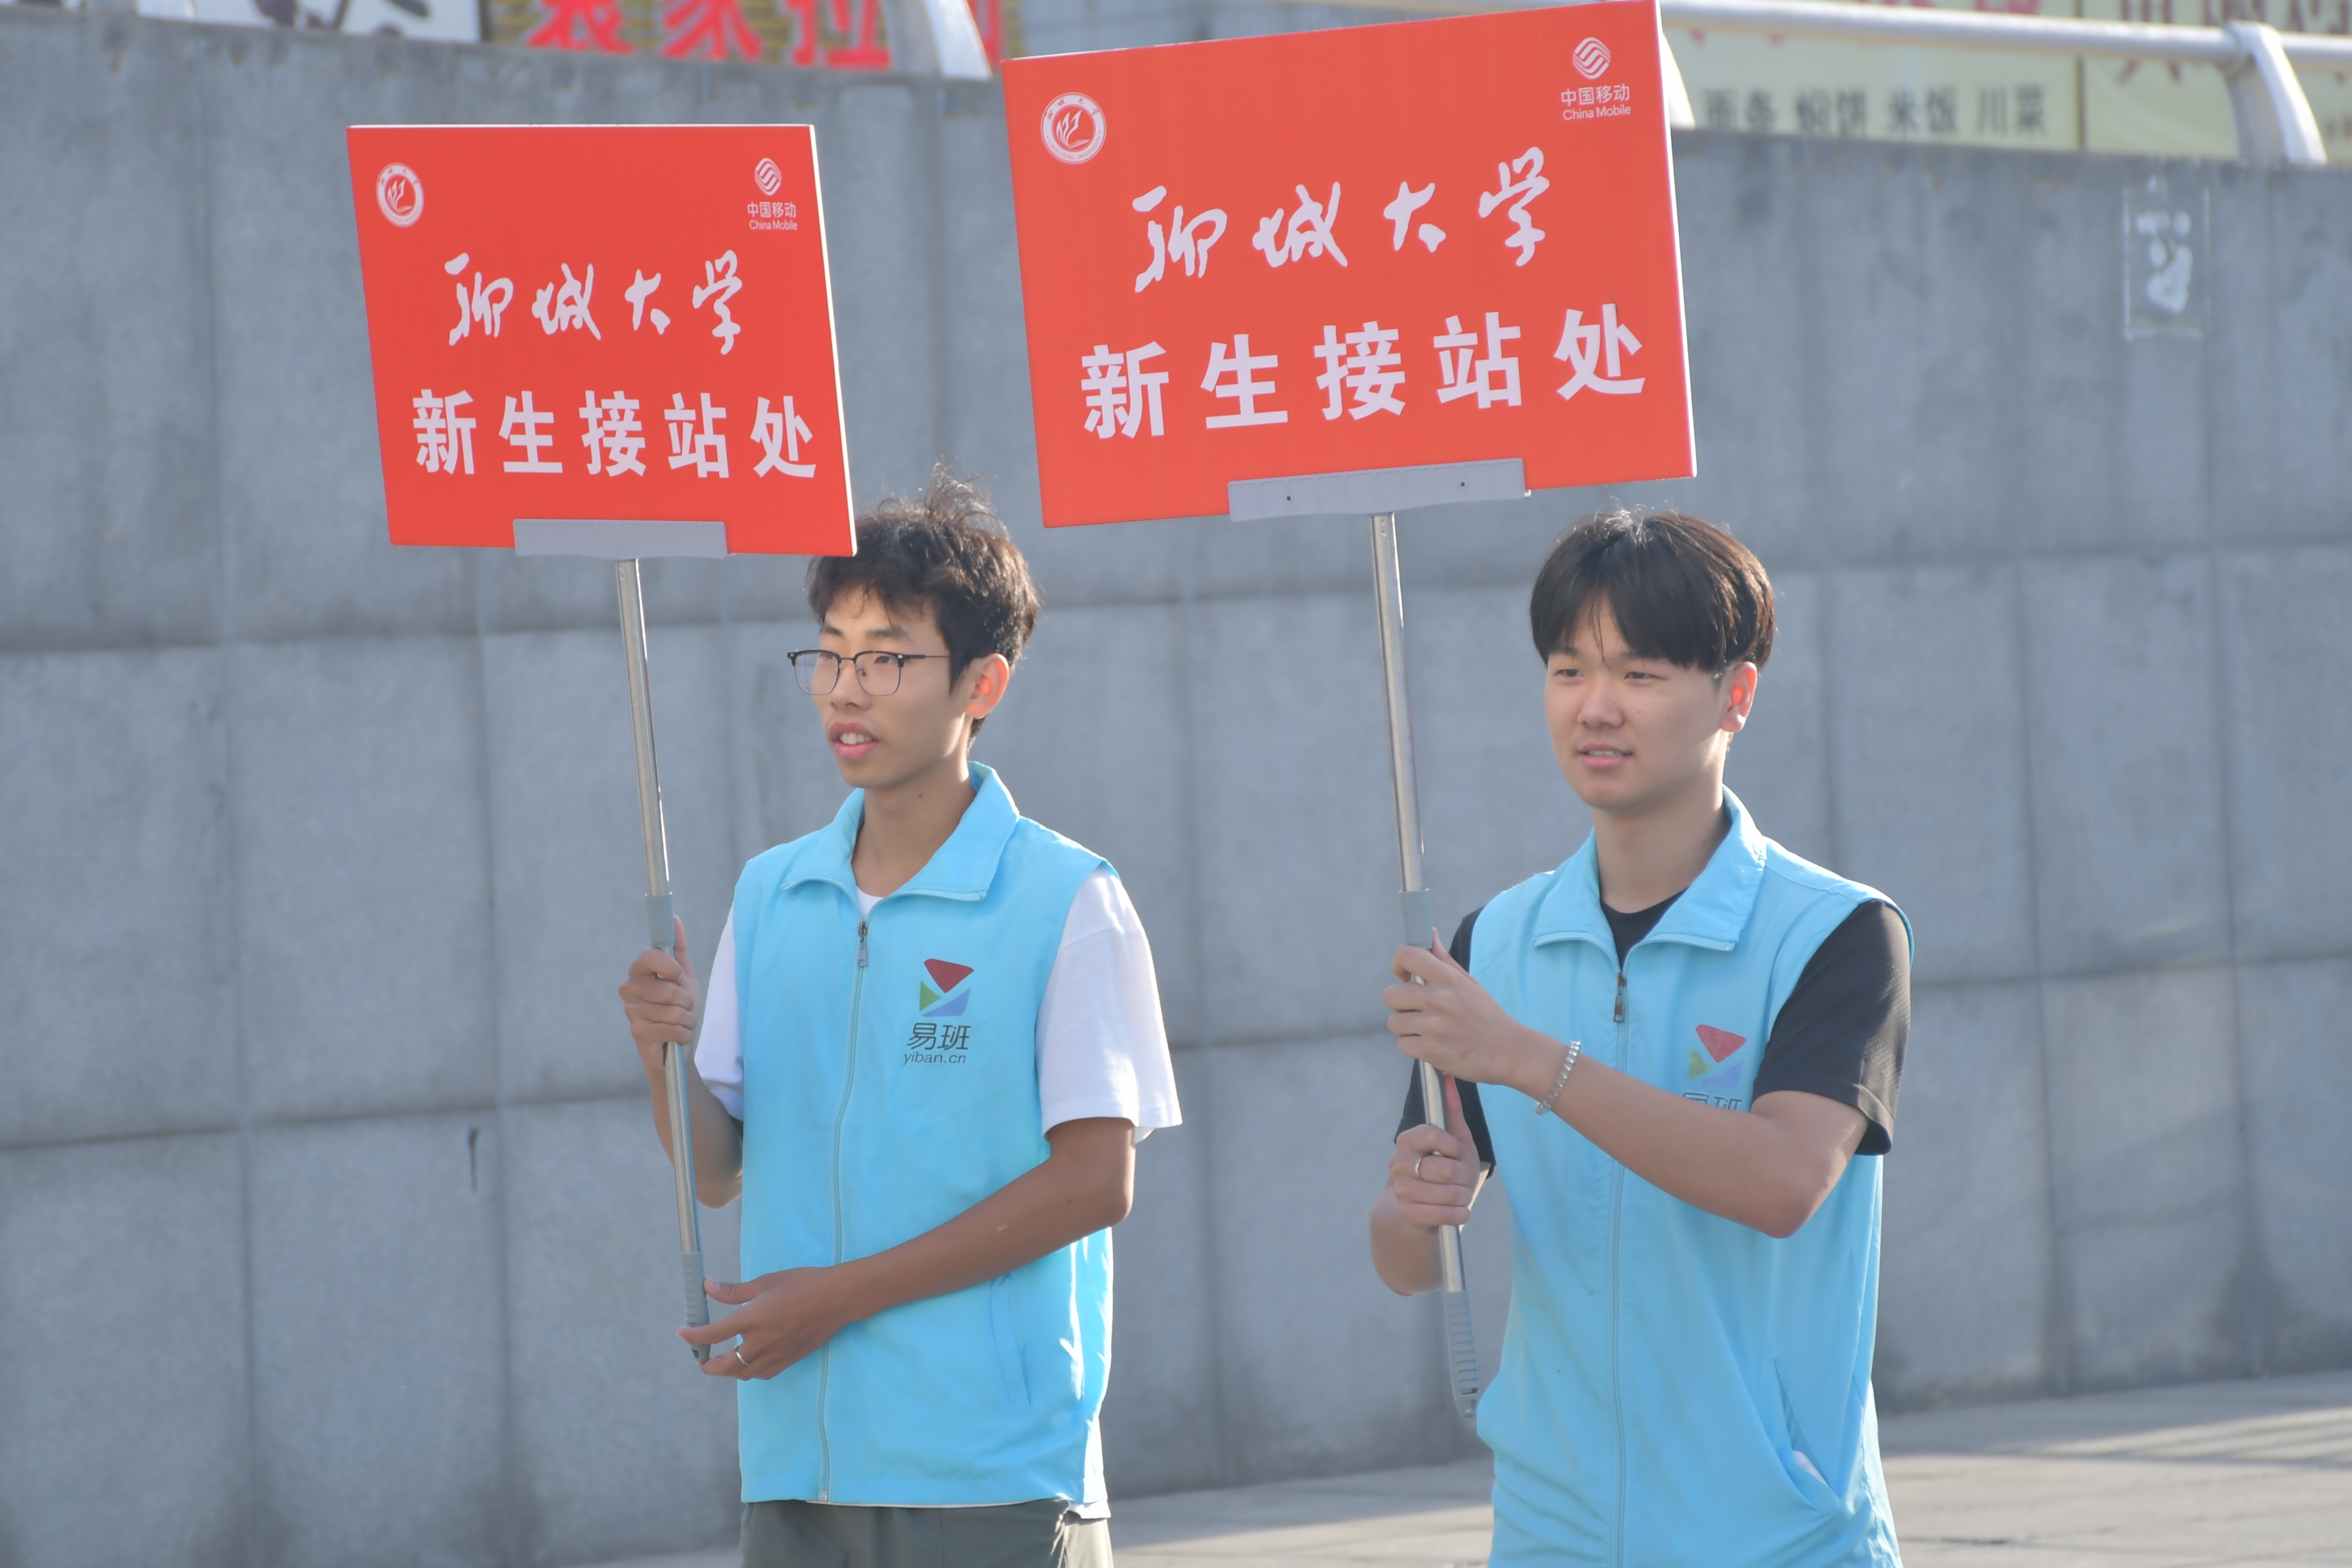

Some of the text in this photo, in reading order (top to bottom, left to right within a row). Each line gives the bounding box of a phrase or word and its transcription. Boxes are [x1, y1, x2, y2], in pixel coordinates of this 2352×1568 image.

[1561, 83, 1630, 107] 中国移动
[1563, 104, 1631, 121] China Mobile
[747, 202, 797, 217] 中国移动
[1132, 146, 1550, 293] 聊城大学
[749, 220, 798, 230] China Mobile
[444, 250, 743, 355] 聊城大学
[1081, 303, 1646, 439] 新生接站处
[413, 389, 816, 478] 新生接站处
[907, 1022, 972, 1050] 易班
[903, 1050, 966, 1066] yiban.cn
